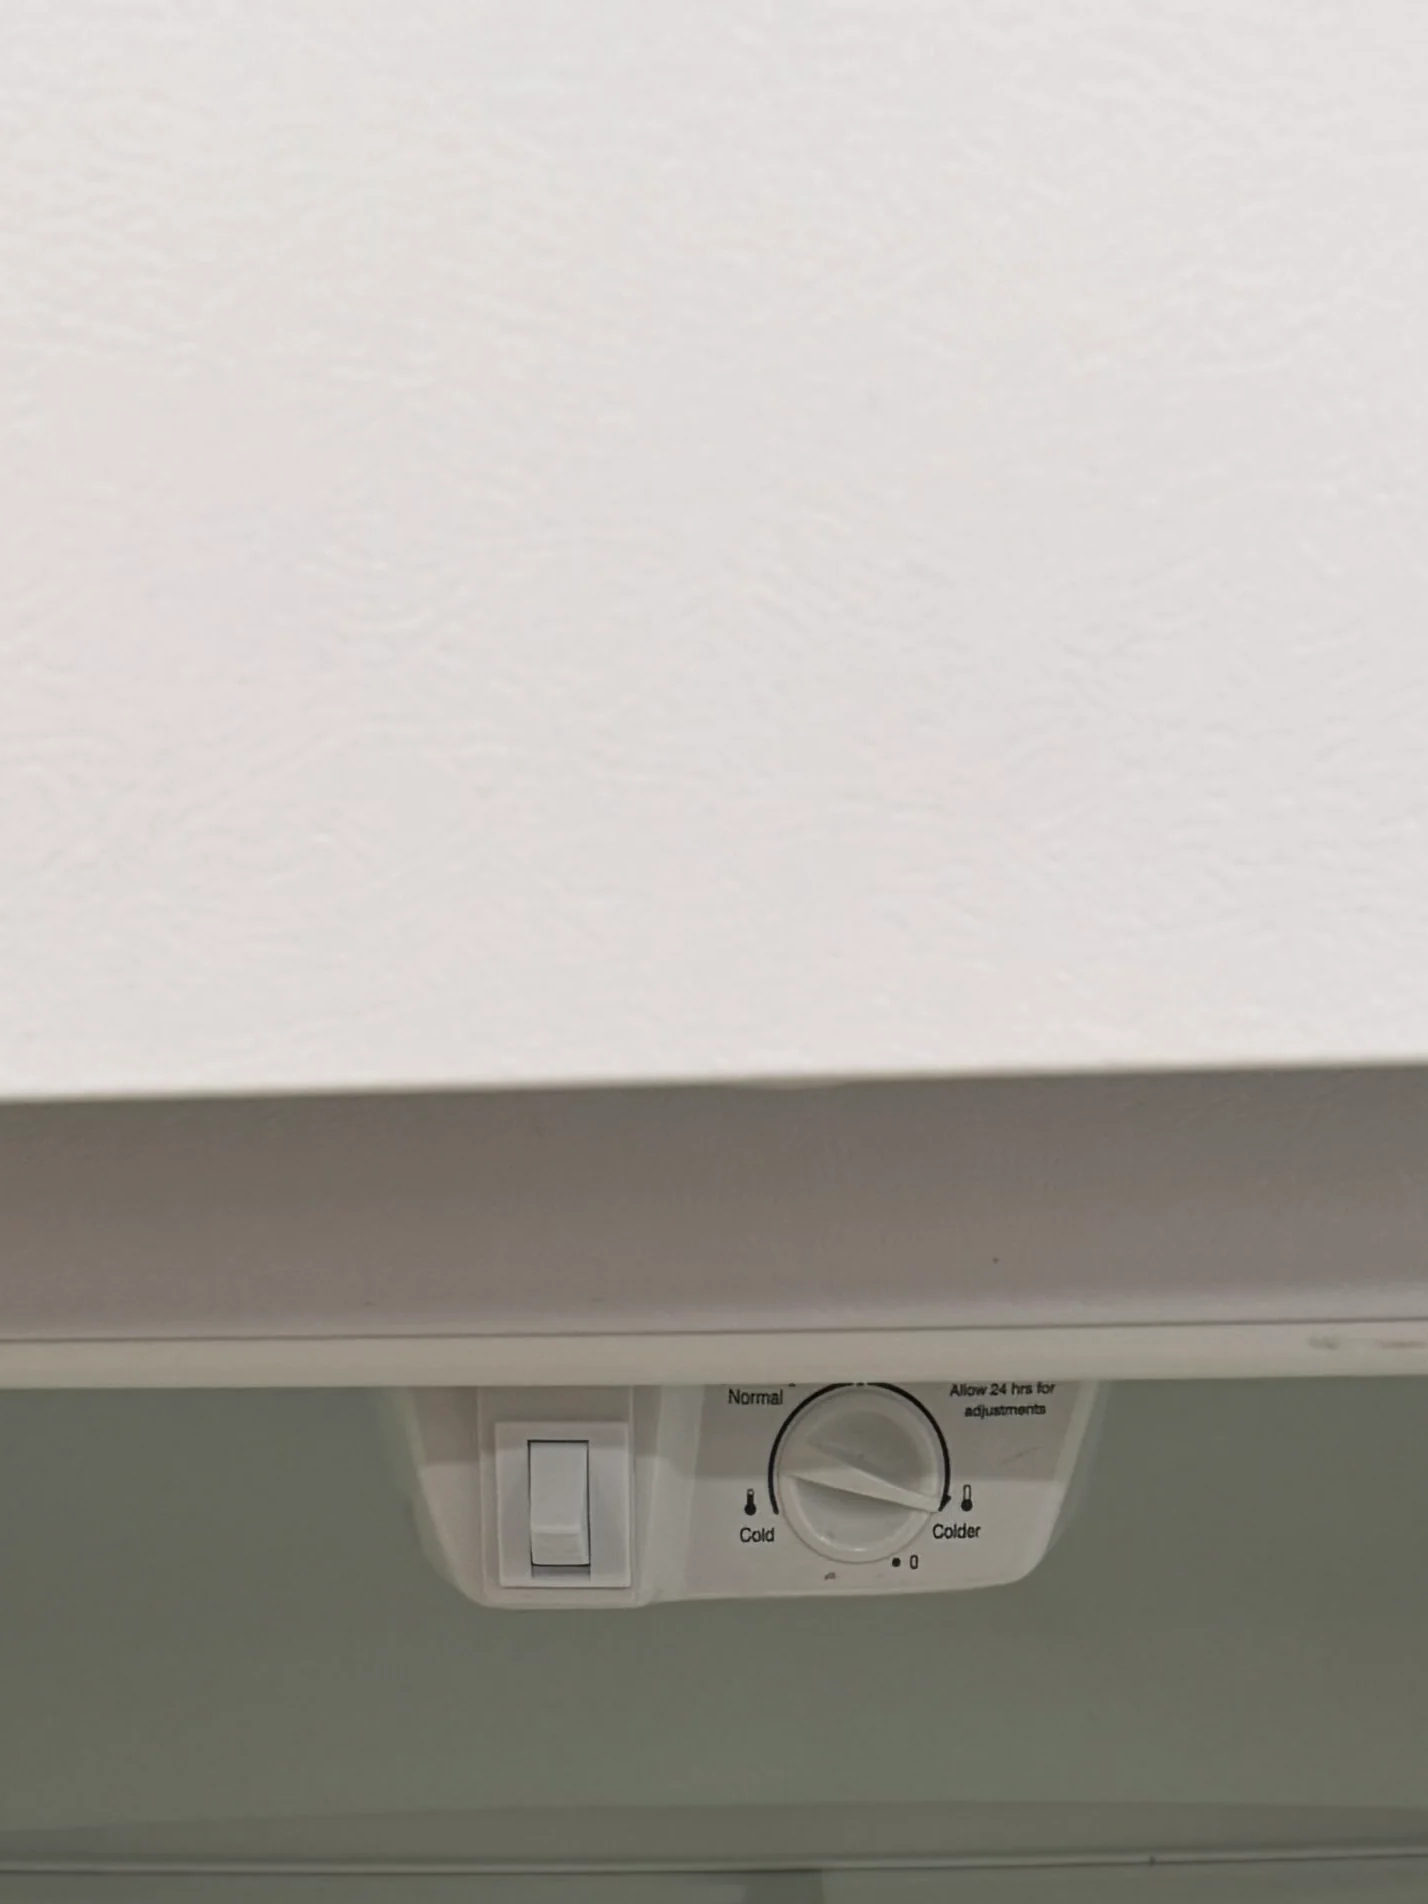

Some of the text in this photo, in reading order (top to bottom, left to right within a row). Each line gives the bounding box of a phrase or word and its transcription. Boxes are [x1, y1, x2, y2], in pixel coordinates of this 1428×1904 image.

[728, 1388, 784, 1406] Normal
[949, 1381, 1056, 1397] Allow 24 hrs for
[964, 1404, 1046, 1419] adjustments
[740, 1527, 775, 1543] Cold
[932, 1523, 981, 1539] Colder
